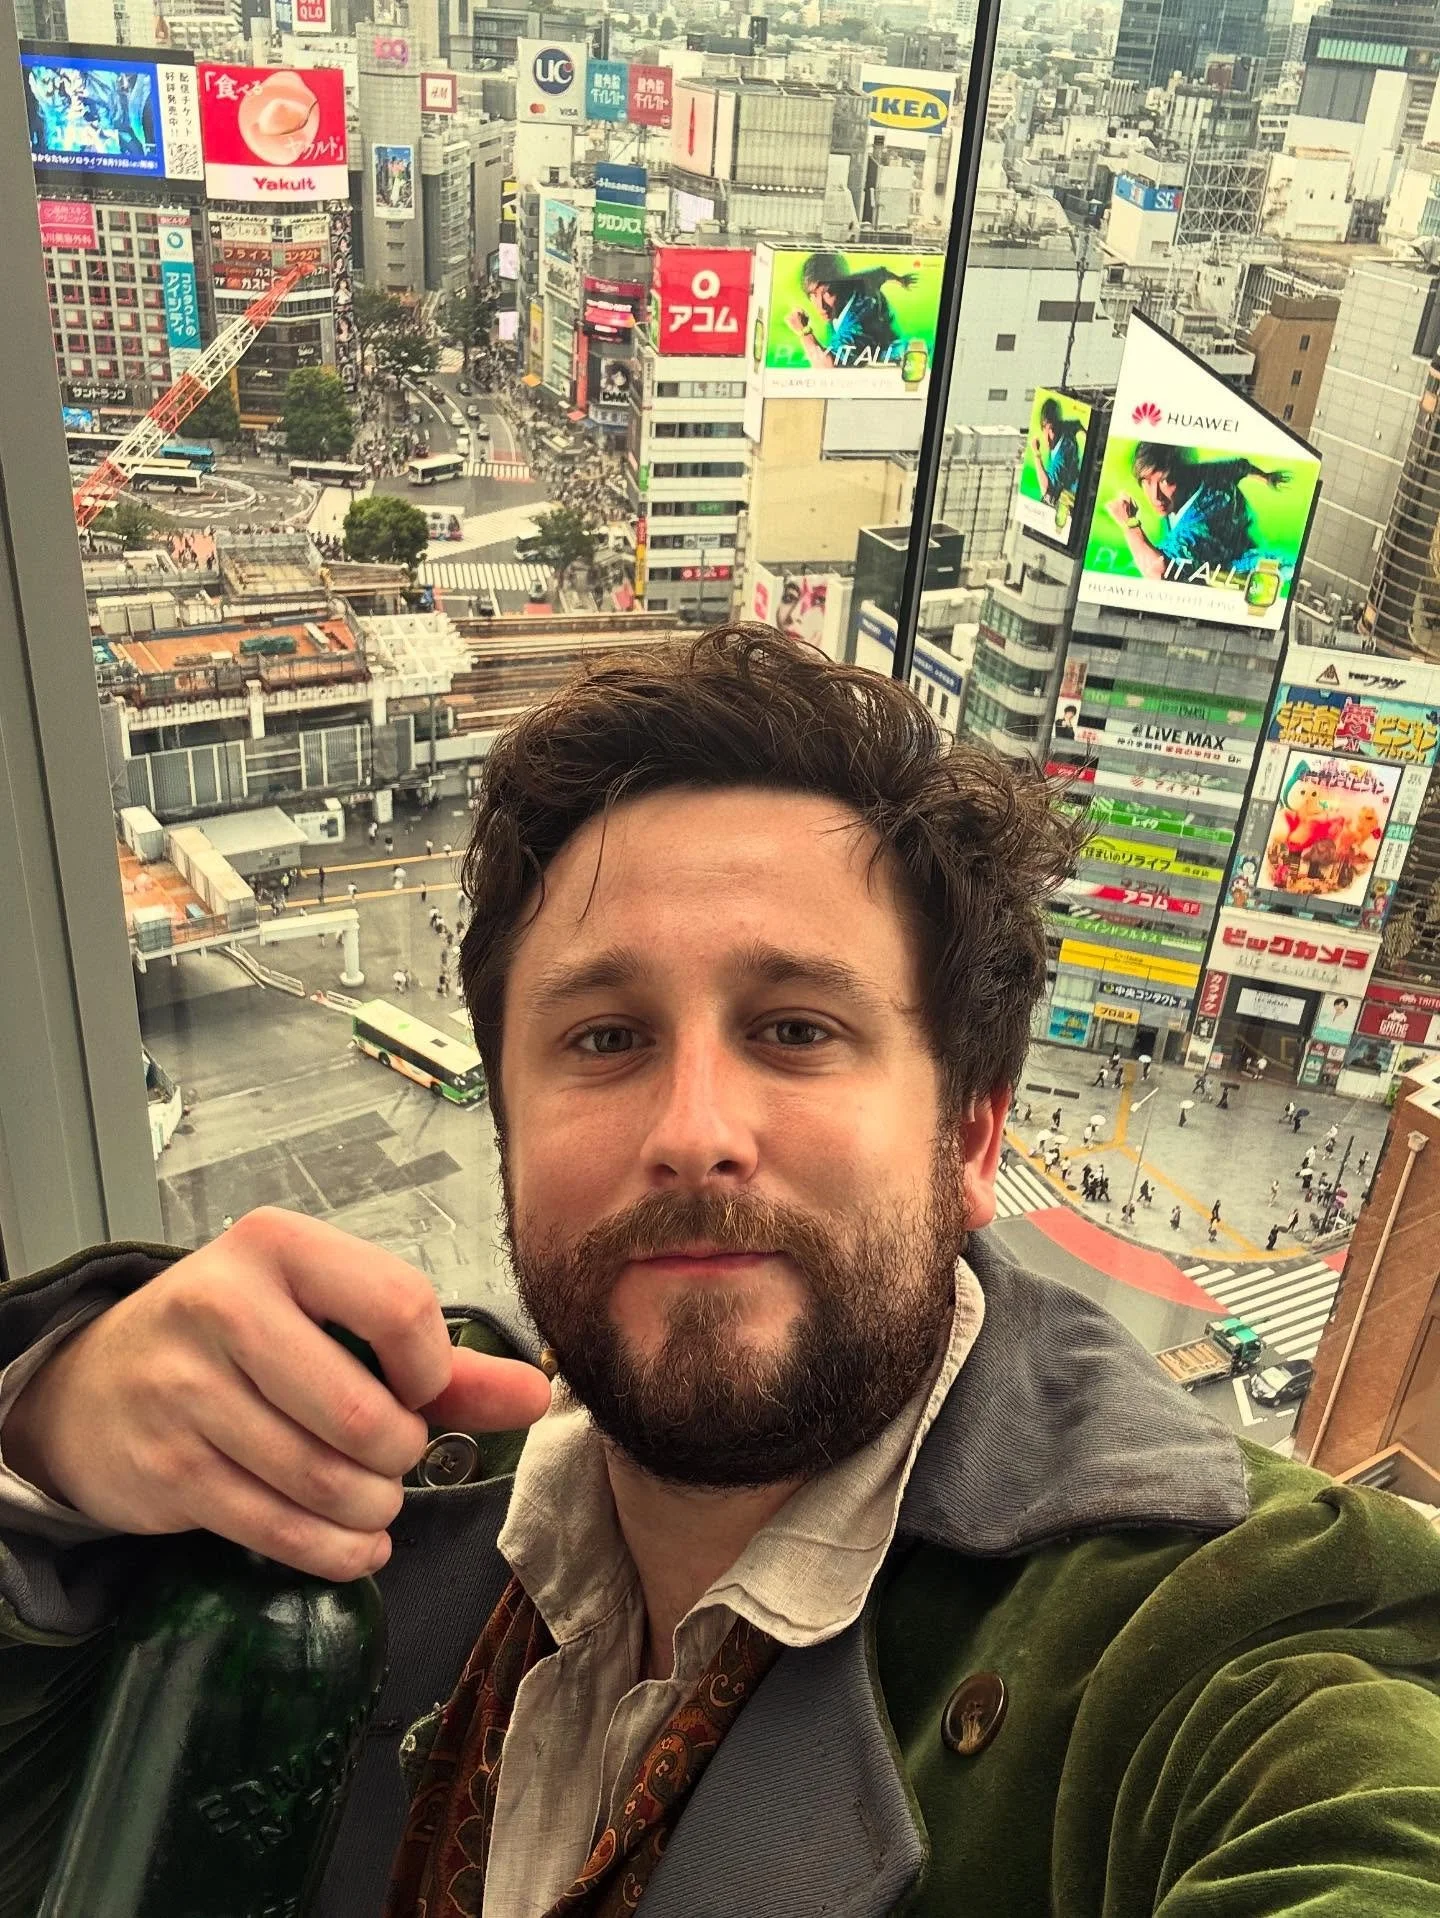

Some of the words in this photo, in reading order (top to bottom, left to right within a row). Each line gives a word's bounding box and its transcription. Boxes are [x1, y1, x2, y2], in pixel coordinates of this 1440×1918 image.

[536, 59, 573, 84] UC
[871, 97, 941, 119] IKEA
[253, 177, 316, 191] Yakult
[668, 305, 738, 333] アコム
[833, 345, 856, 366] IT
[853, 345, 897, 367] ALL
[1167, 412, 1240, 433] HUAWEI
[1164, 557, 1193, 581] IT
[1188, 561, 1240, 590] ALL
[1186, 731, 1226, 750] MAX
[1122, 890, 1168, 910] アコム
[1222, 926, 1370, 970] ビックカメラ
[1115, 985, 1177, 1007] 中央コンタクト
